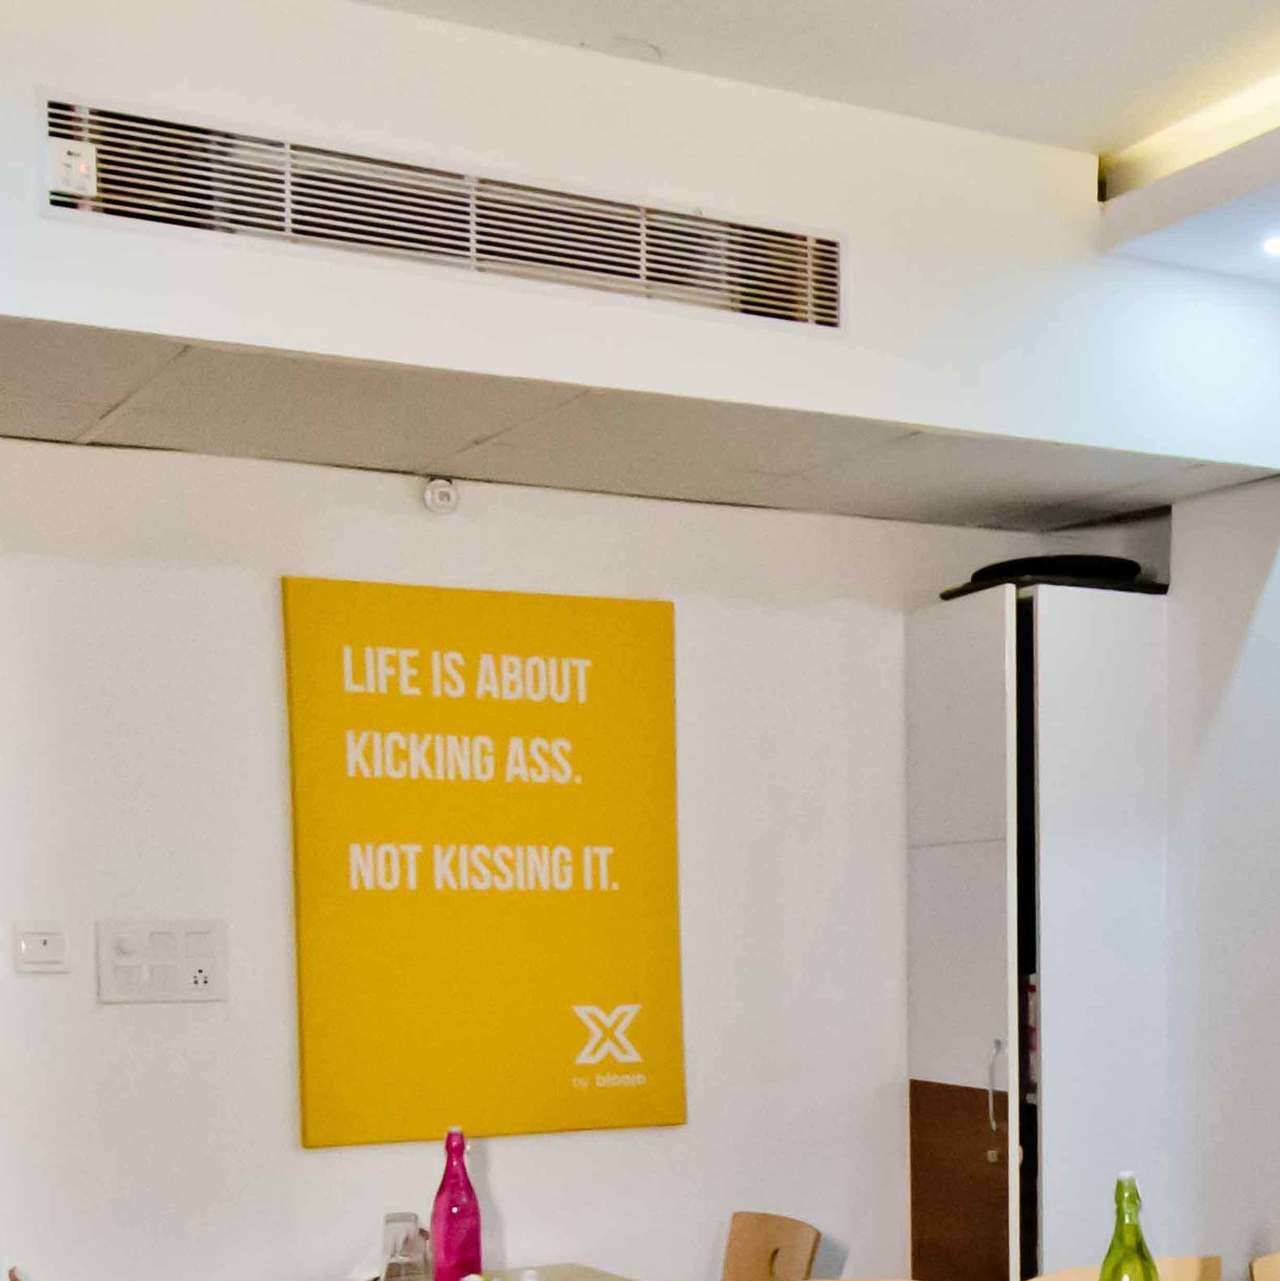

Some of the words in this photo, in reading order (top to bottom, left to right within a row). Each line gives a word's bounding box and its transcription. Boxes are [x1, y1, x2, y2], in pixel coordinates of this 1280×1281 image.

[343, 646, 421, 696] LIFE
[431, 650, 466, 698] IS
[476, 654, 592, 703] ABOUT
[346, 730, 495, 781] KICKING
[505, 736, 583, 785] ASS.
[349, 843, 422, 890] NOT
[433, 844, 573, 891] KISSING
[583, 846, 619, 890] IT.
